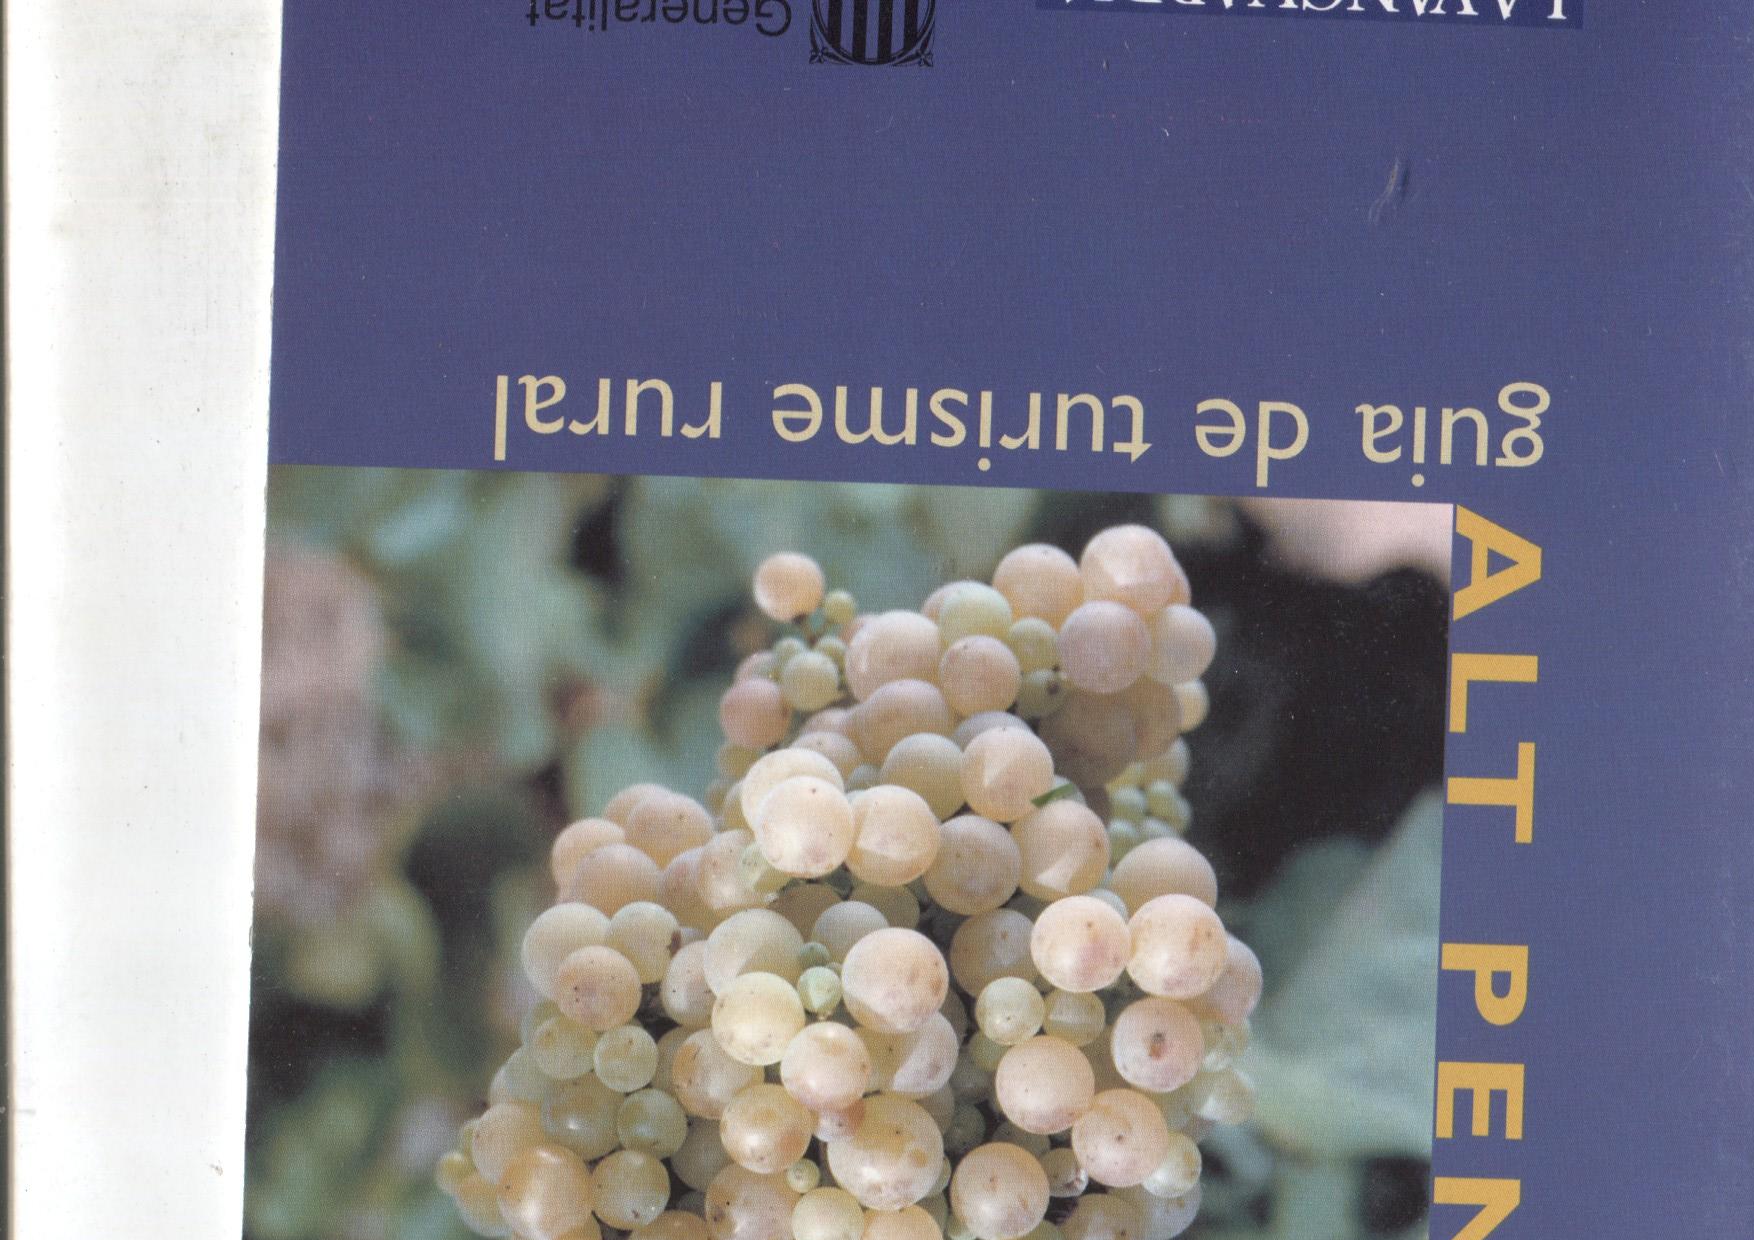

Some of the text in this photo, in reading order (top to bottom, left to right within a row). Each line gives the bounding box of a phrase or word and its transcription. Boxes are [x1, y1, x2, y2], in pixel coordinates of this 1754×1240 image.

[524, 0, 793, 38] Generalitat
[494, 375, 1551, 487] guia de turisme rural
[1446, 505, 1542, 845] ALT
